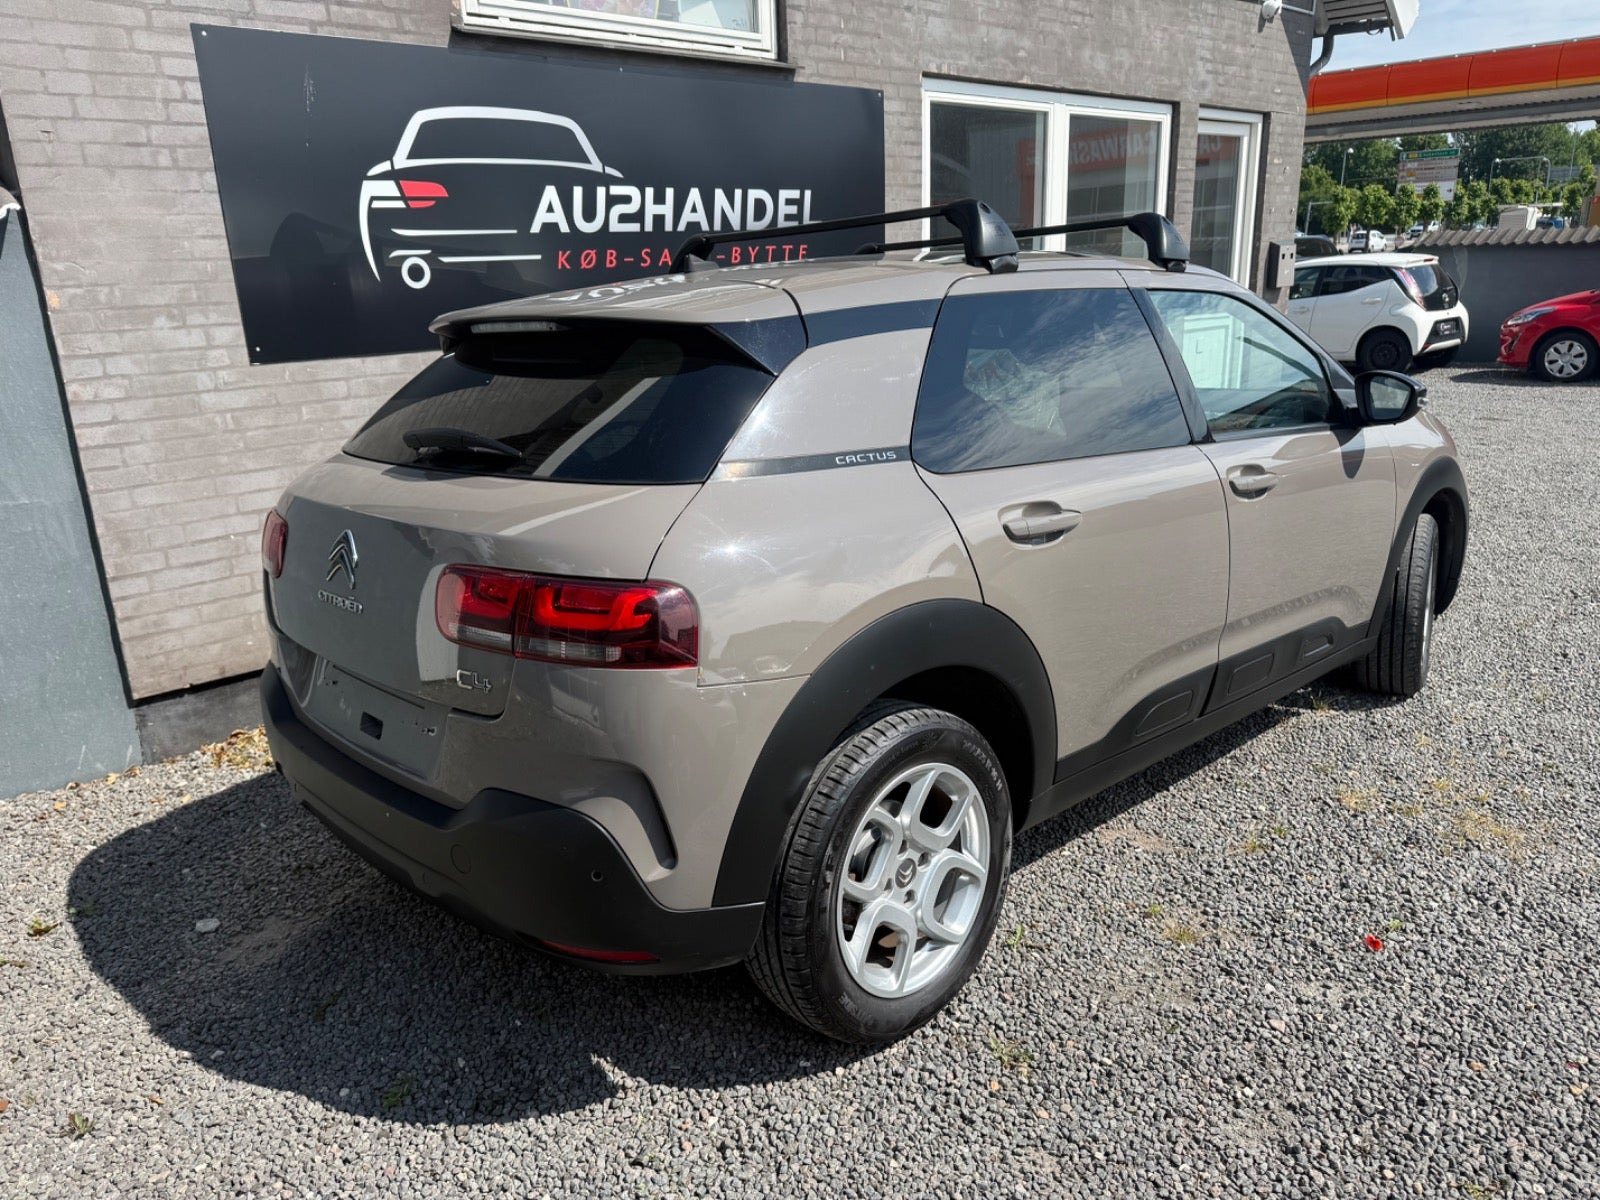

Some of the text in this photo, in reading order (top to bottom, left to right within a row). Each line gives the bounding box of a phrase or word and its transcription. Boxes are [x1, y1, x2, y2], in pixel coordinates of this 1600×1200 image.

[835, 451, 896, 465] CACTUS
[318, 589, 362, 614] CITROËN
[457, 669, 491, 693] C4
